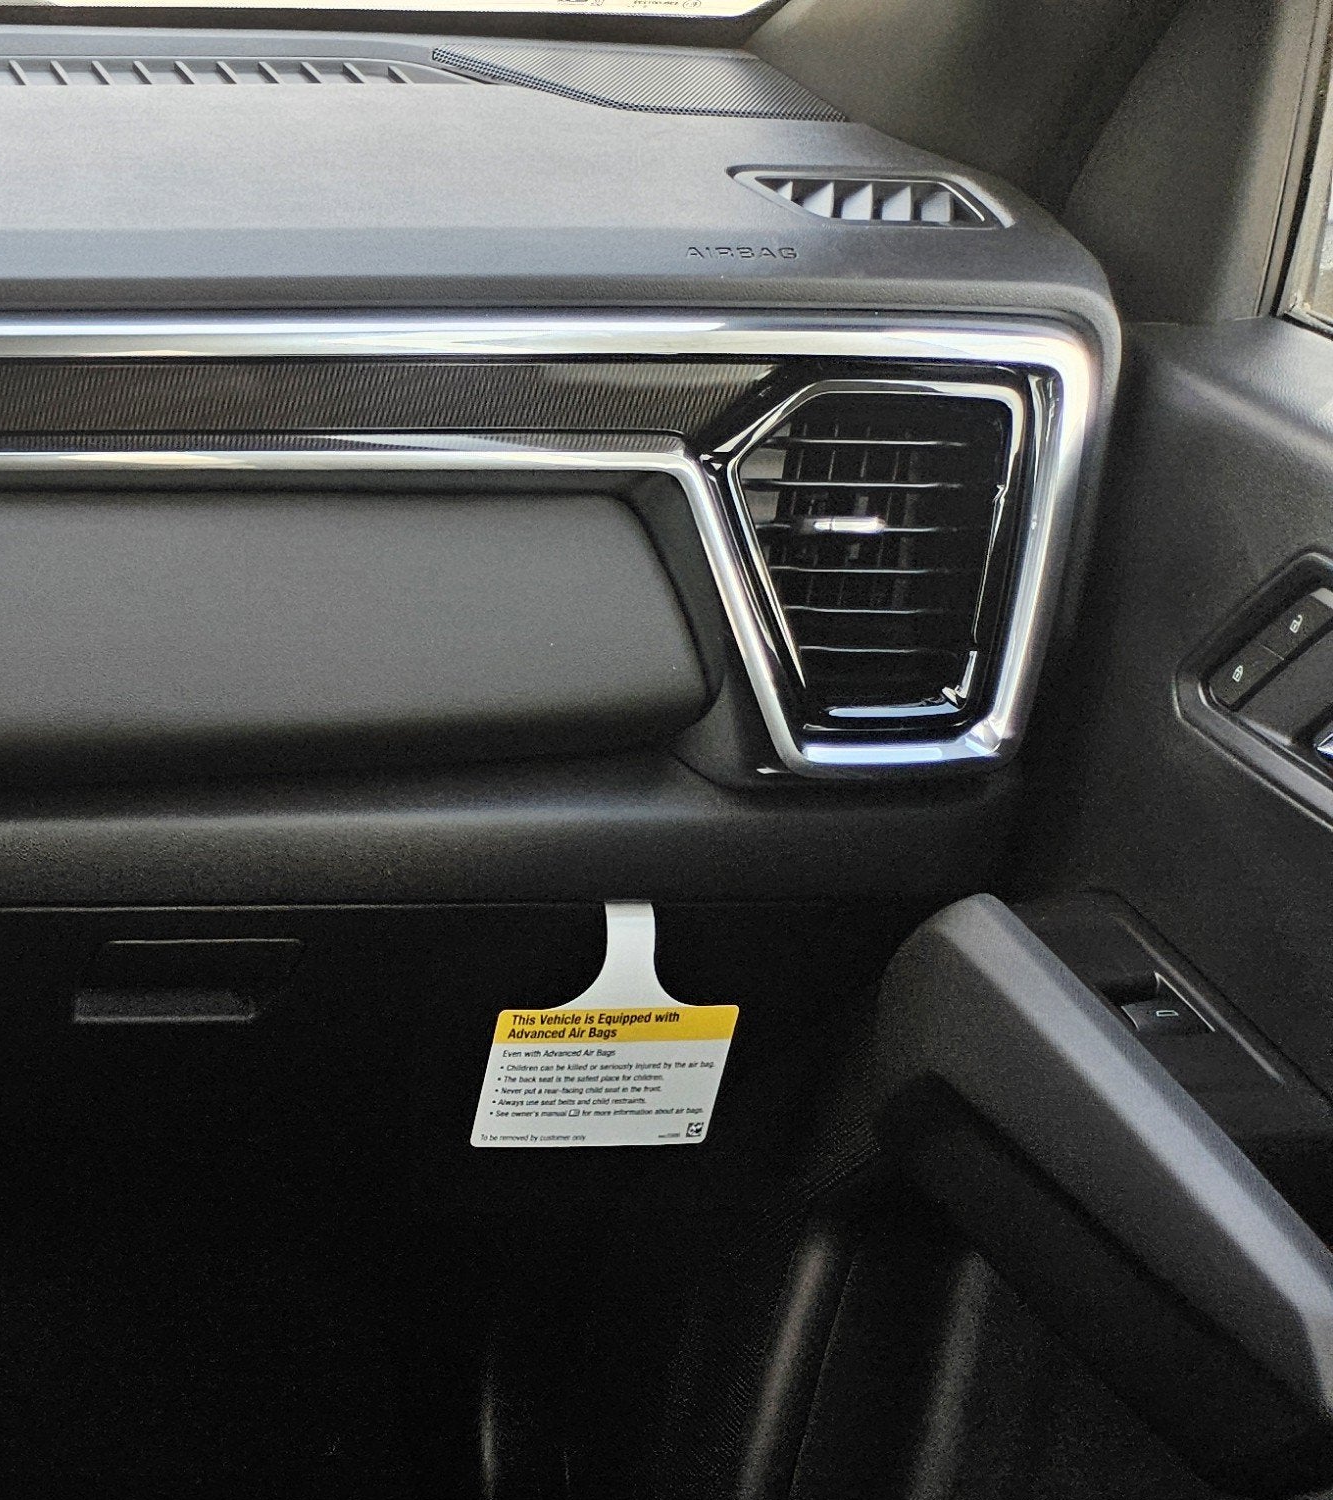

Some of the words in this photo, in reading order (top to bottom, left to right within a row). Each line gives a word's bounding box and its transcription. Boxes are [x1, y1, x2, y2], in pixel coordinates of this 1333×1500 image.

[685, 246, 800, 261] AIRBAG
[512, 1015, 535, 1026] This
[540, 1013, 581, 1025] Vehicle
[585, 1013, 594, 1024] is
[598, 1012, 651, 1026] Equipped
[655, 1011, 680, 1023] with
[508, 1027, 566, 1039] Advanced
[568, 1027, 584, 1038] Air
[588, 1027, 617, 1040] Bags
[502, 1050, 522, 1058] Even
[543, 1049, 582, 1057] Advanced
[583, 1049, 594, 1057] Air
[596, 1049, 616, 1058] Bags
[600, 1063, 632, 1071] seriously
[635, 1062, 661, 1070] injured
[498, 1099, 524, 1107] Always
